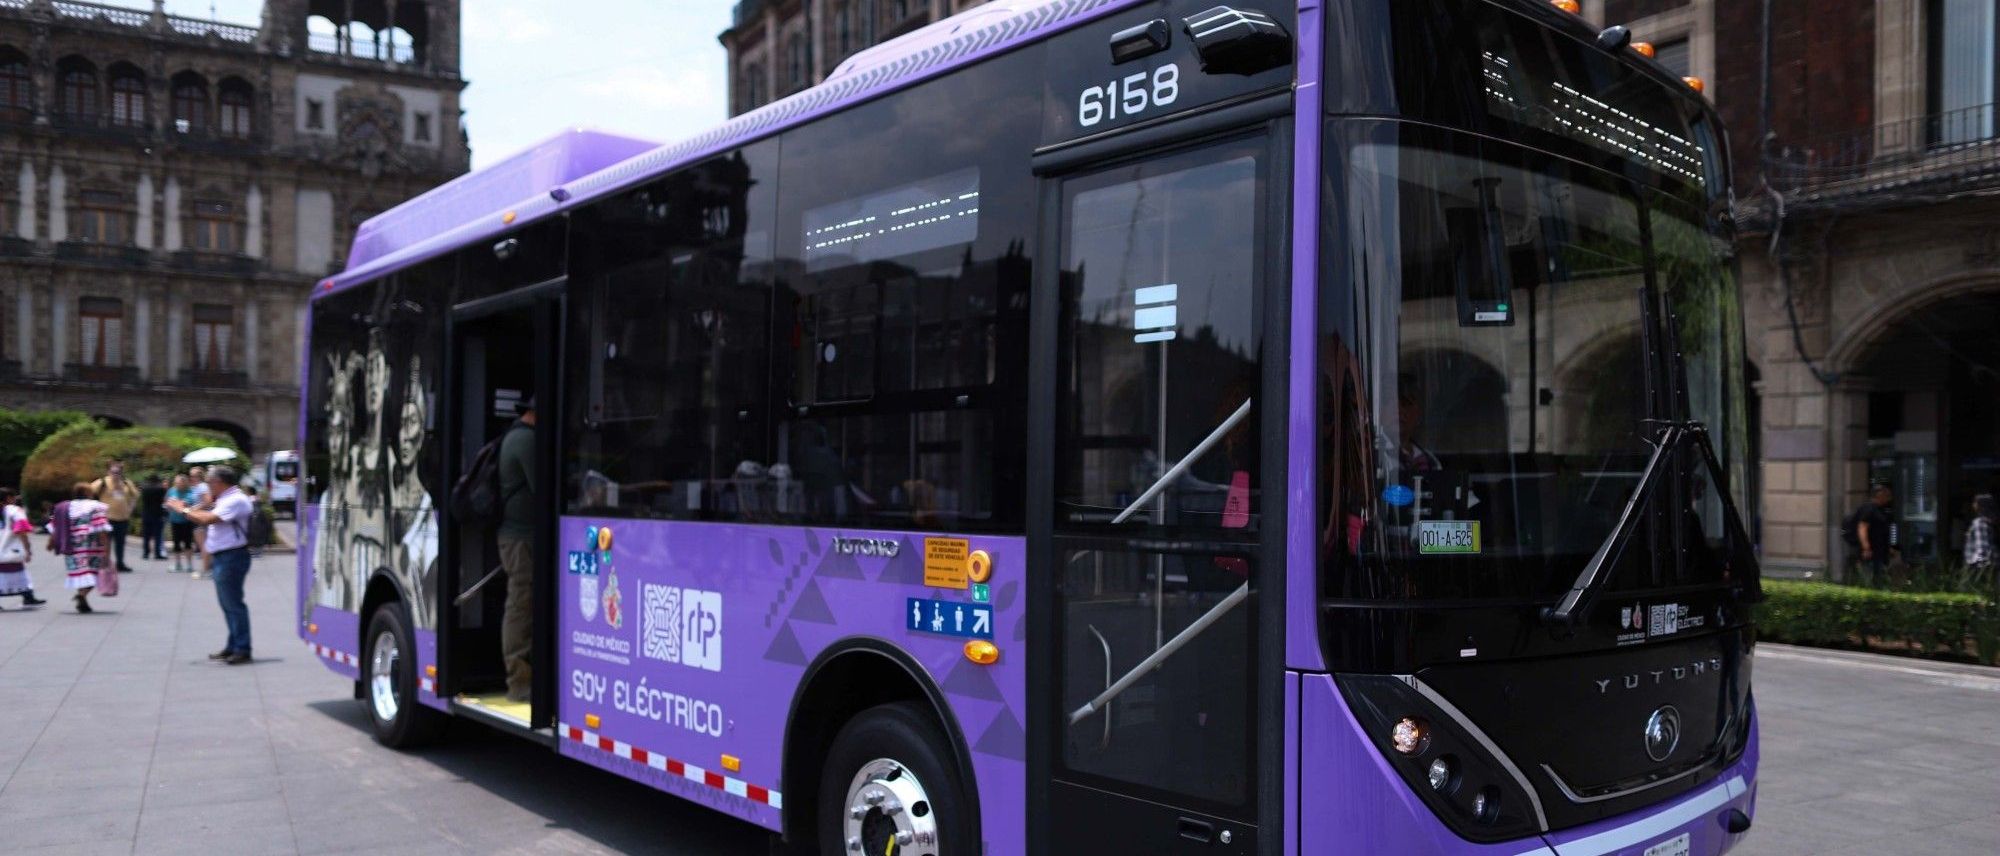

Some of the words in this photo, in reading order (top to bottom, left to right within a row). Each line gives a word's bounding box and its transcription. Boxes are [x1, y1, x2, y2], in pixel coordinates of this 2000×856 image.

[1079, 63, 1179, 126] 6158
[832, 536, 899, 558] YUTONG
[1422, 530, 1473, 547] 001-A-525
[1596, 659, 1721, 693] YUTONG
[572, 669, 607, 704] SOY
[613, 676, 722, 738] ELÉCTRICO
